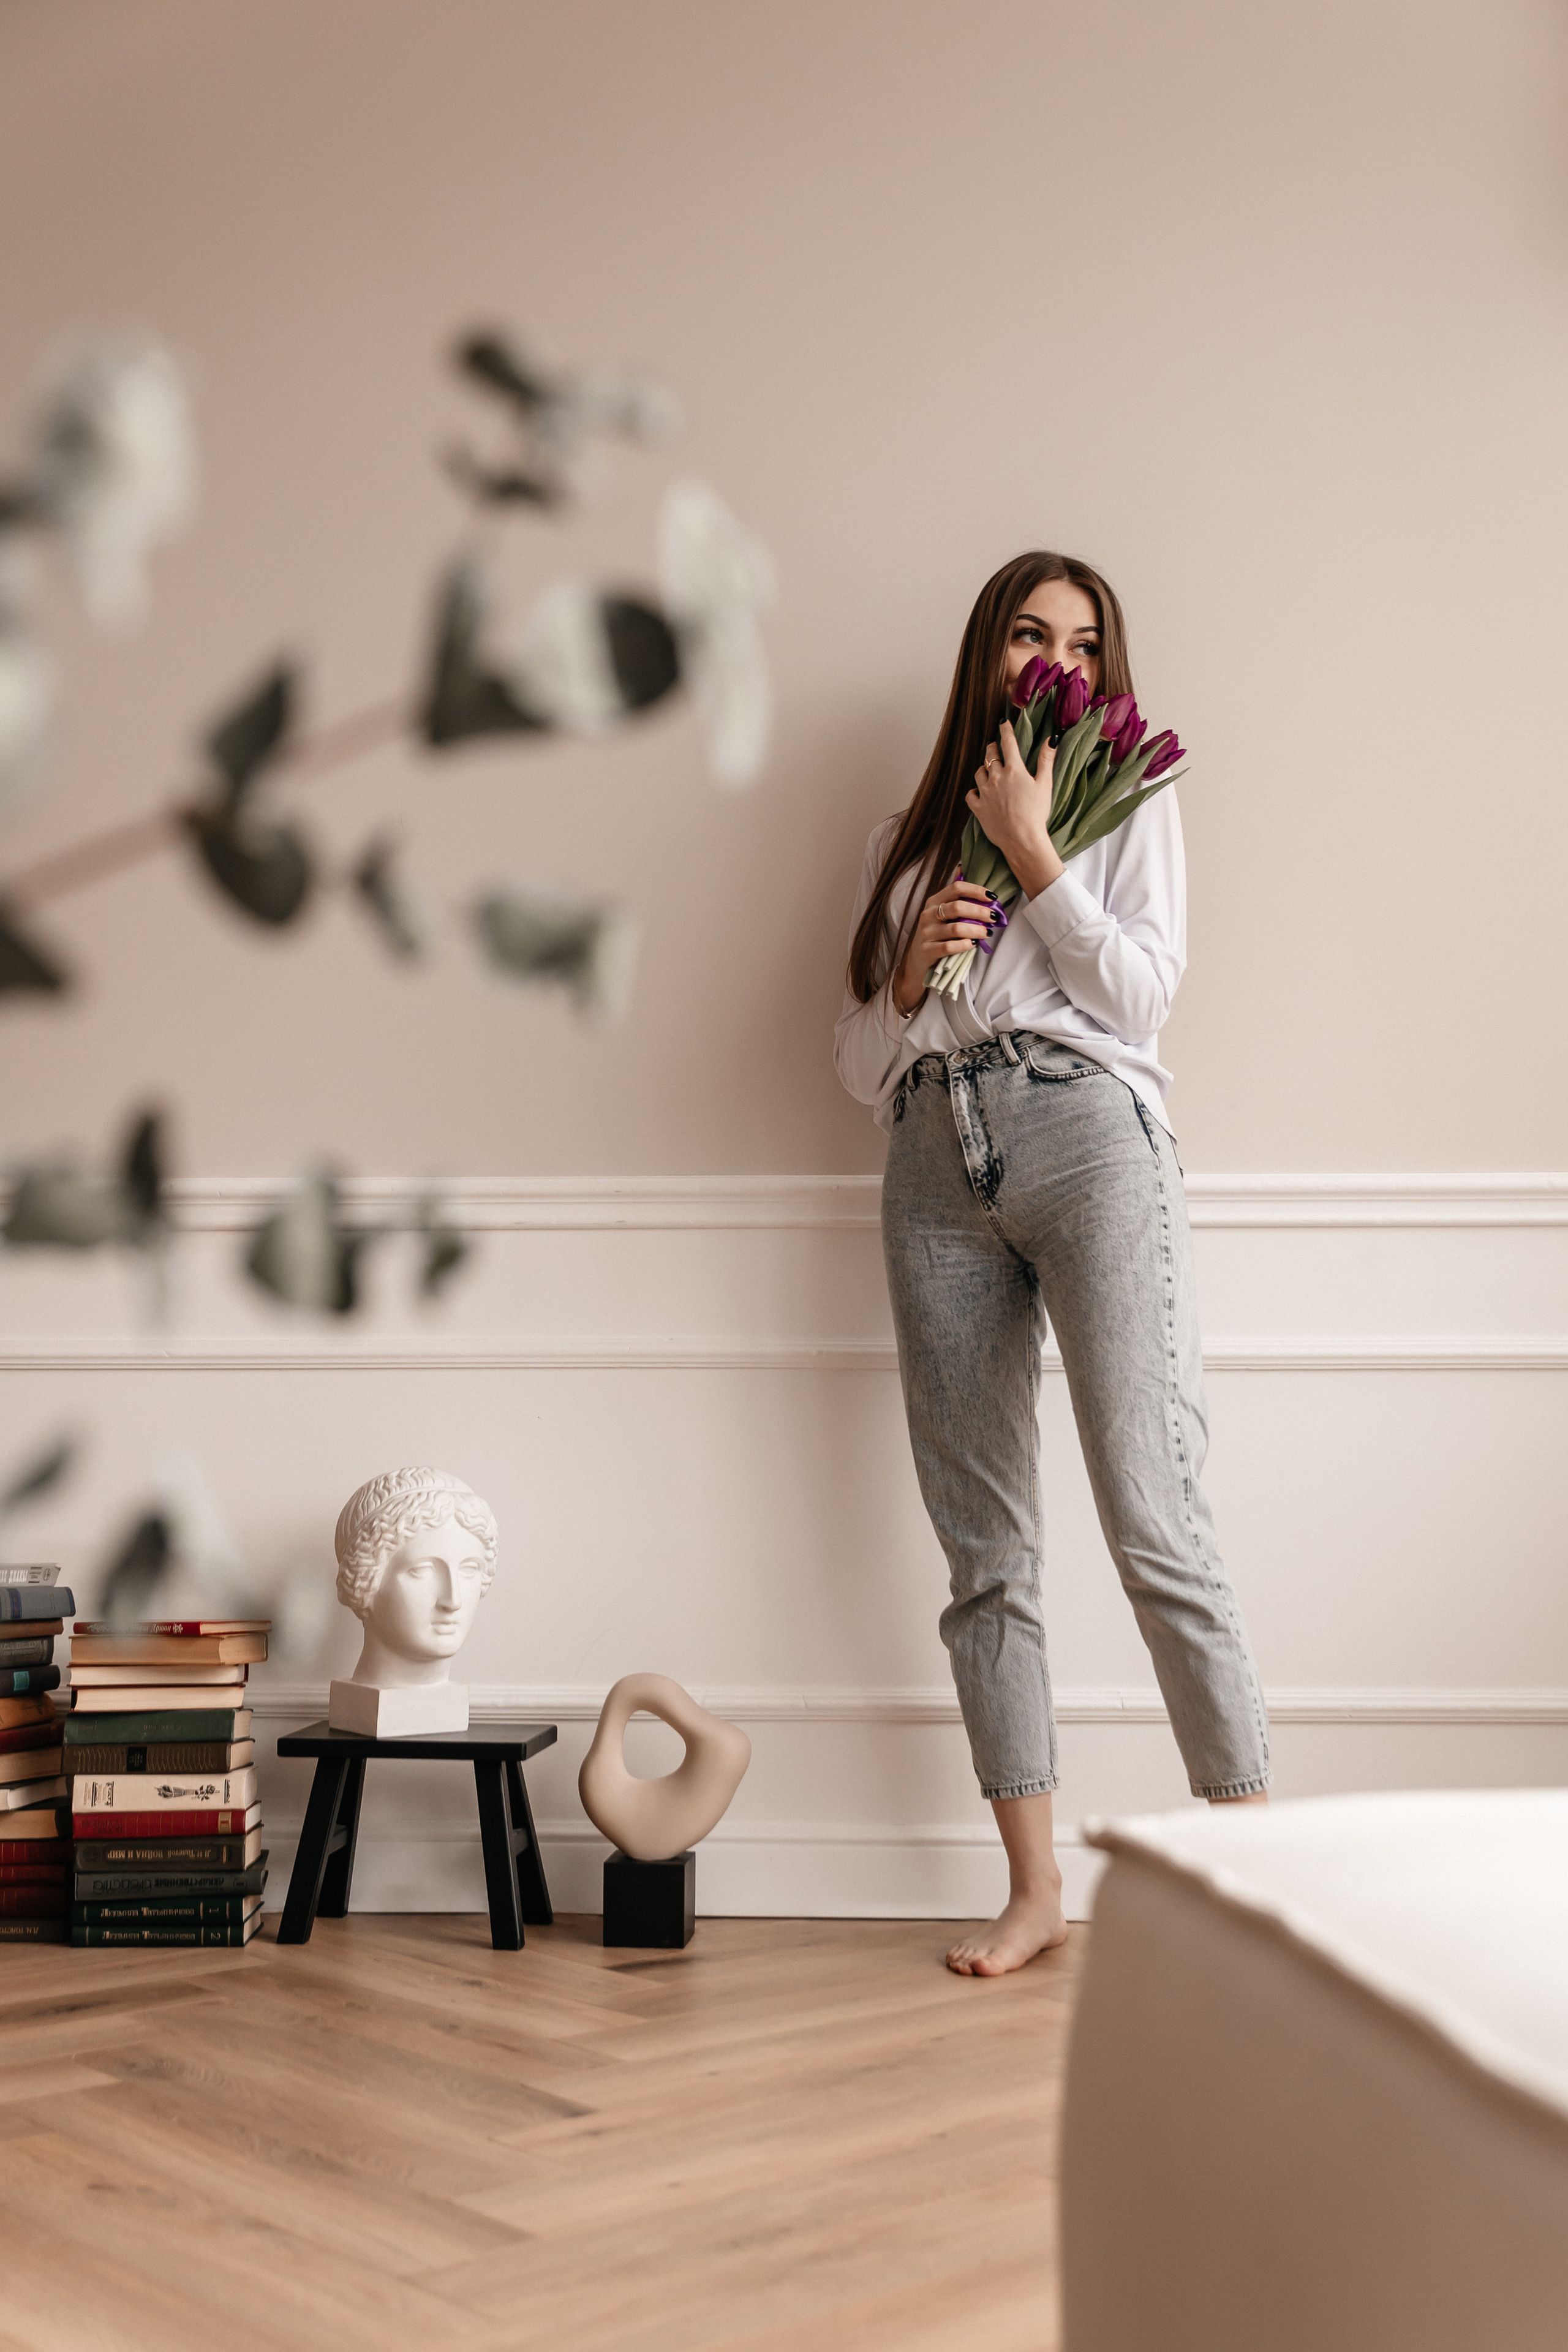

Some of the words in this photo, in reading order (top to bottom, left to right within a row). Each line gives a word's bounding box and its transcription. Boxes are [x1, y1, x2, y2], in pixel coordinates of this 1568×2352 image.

[150, 1624, 172, 1633] Дрюон
[107, 1850, 126, 1859] МИР
[211, 1932, 221, 1940] 2
